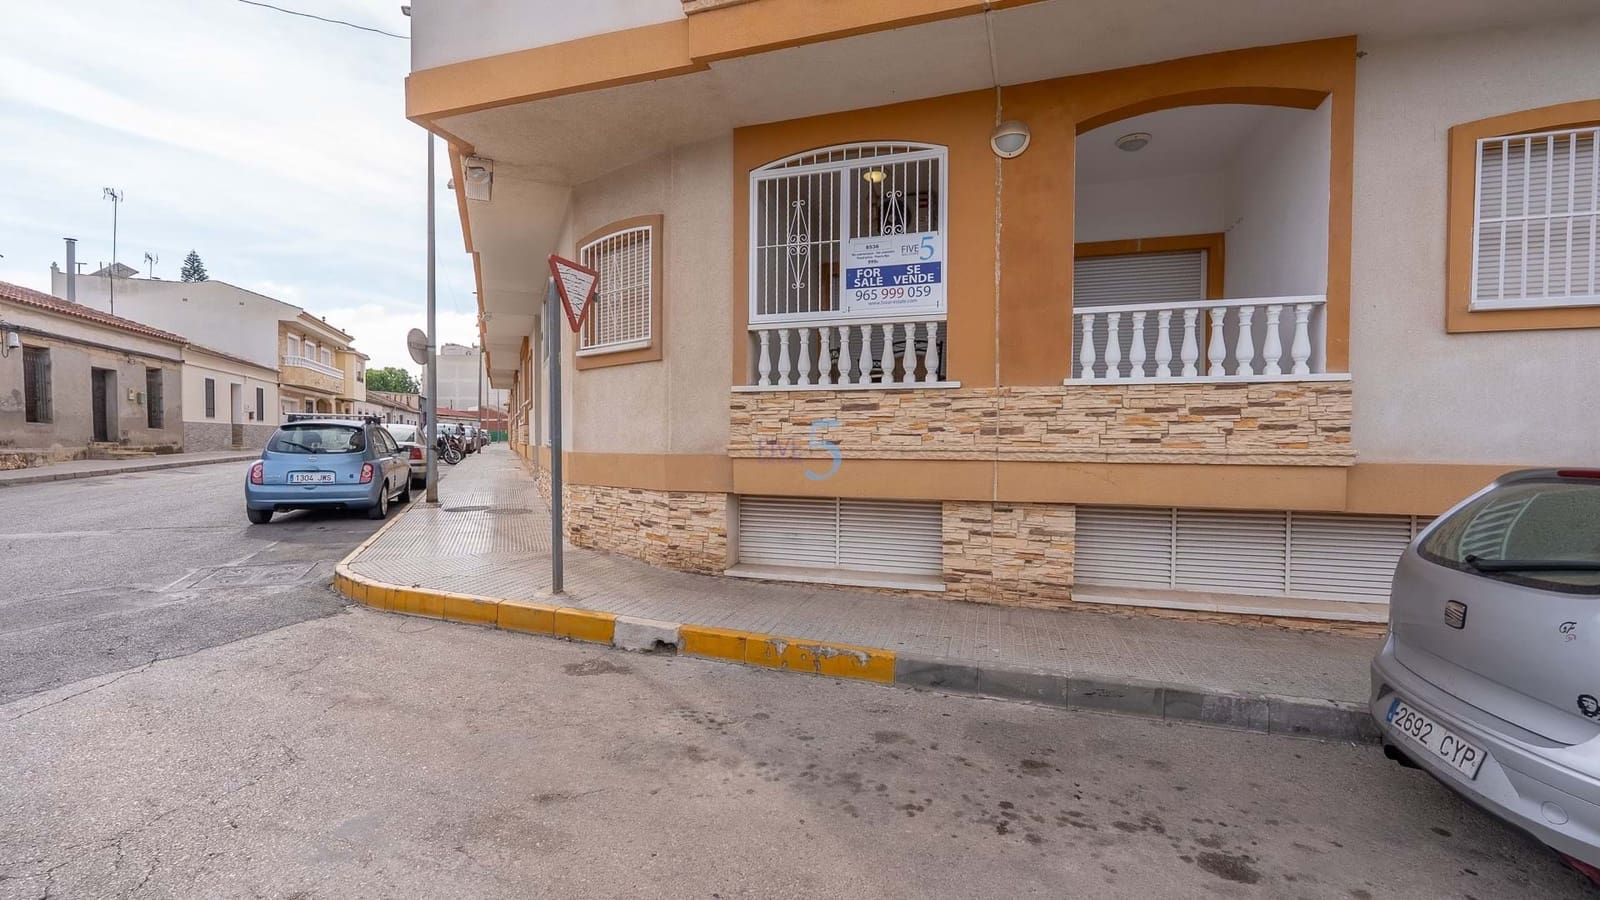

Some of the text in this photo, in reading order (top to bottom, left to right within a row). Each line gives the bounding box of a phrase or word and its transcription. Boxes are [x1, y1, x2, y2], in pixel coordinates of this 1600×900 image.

[901, 244, 919, 253] FIVE
[920, 236, 934, 260] 5
[856, 268, 881, 278] FOR
[906, 265, 921, 274] SE
[854, 277, 883, 287] SALE
[893, 273, 934, 284] VENDE
[855, 285, 931, 301] 965 999 059
[1395, 707, 1476, 768] 2692 CYP
